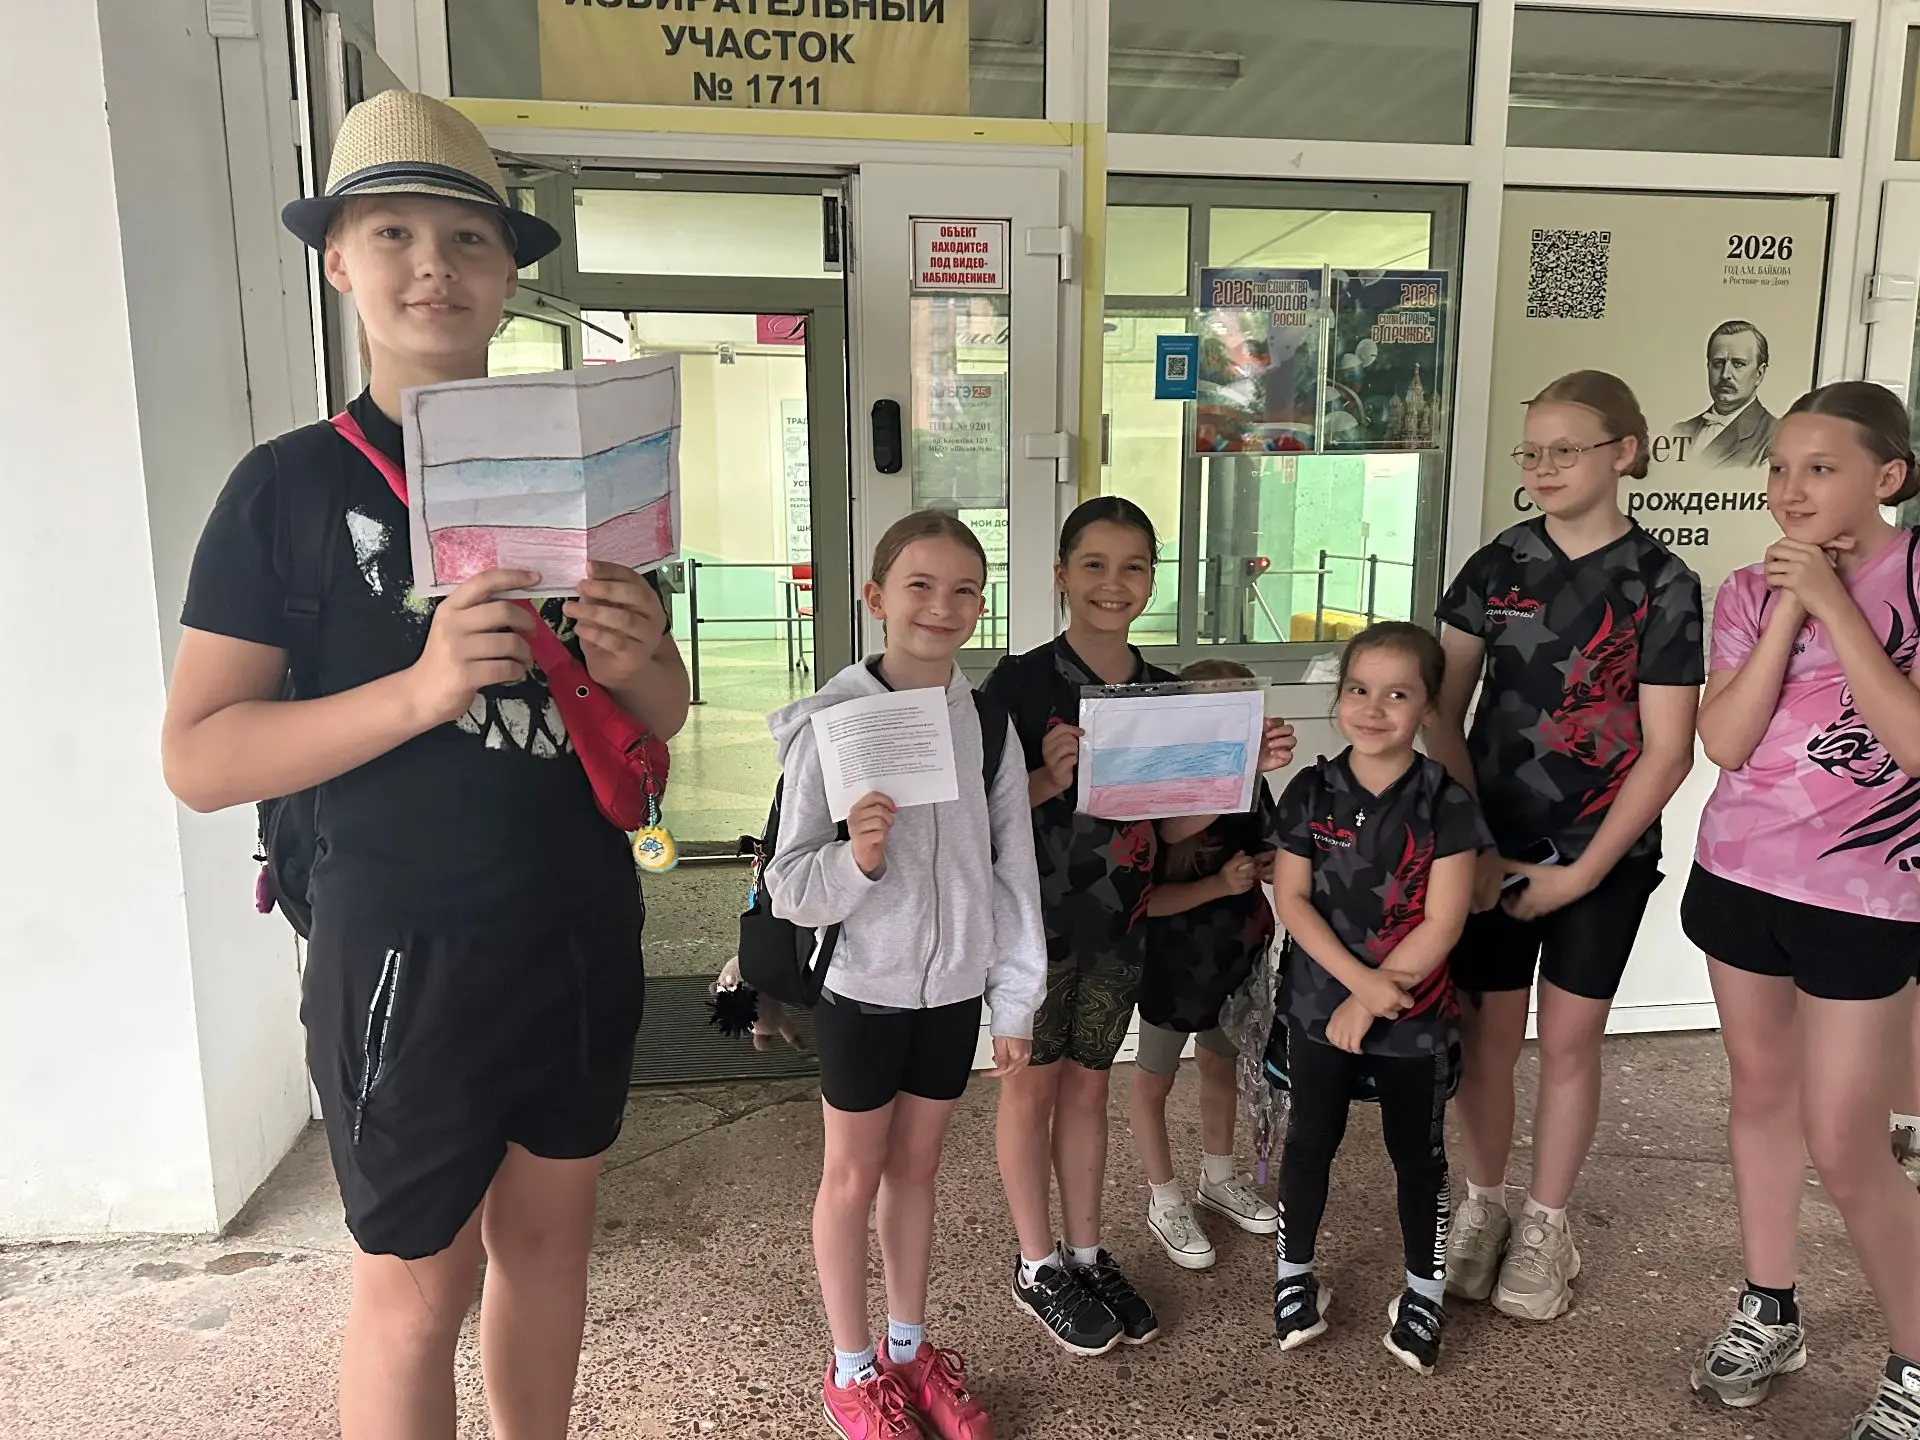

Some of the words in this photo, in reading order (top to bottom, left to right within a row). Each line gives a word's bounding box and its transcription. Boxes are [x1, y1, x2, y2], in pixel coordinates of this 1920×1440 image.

[660, 24, 856, 64] УЧАСТОК
[693, 71, 734, 101] №
[746, 74, 822, 105] 1711
[940, 226, 977, 238] ОБЪЕКТ
[931, 241, 989, 254] НАХОДИТСЯ
[1726, 234, 1793, 261] 2026
[930, 257, 951, 270] ПОД
[953, 257, 989, 270] ВИДЕО-
[1723, 265, 1739, 276] ГОД
[1757, 264, 1792, 276] БАЙКОВА
[922, 272, 996, 285] НАБЛЮДЕНИЕМ
[1213, 280, 1252, 305] 2026
[1252, 294, 1308, 311] НАРОДОВ
[1401, 284, 1437, 307] 2026
[1652, 435, 1692, 462] ет
[1628, 492, 1770, 516] рождения
[1433, 1216, 1448, 1265] MICKEY
